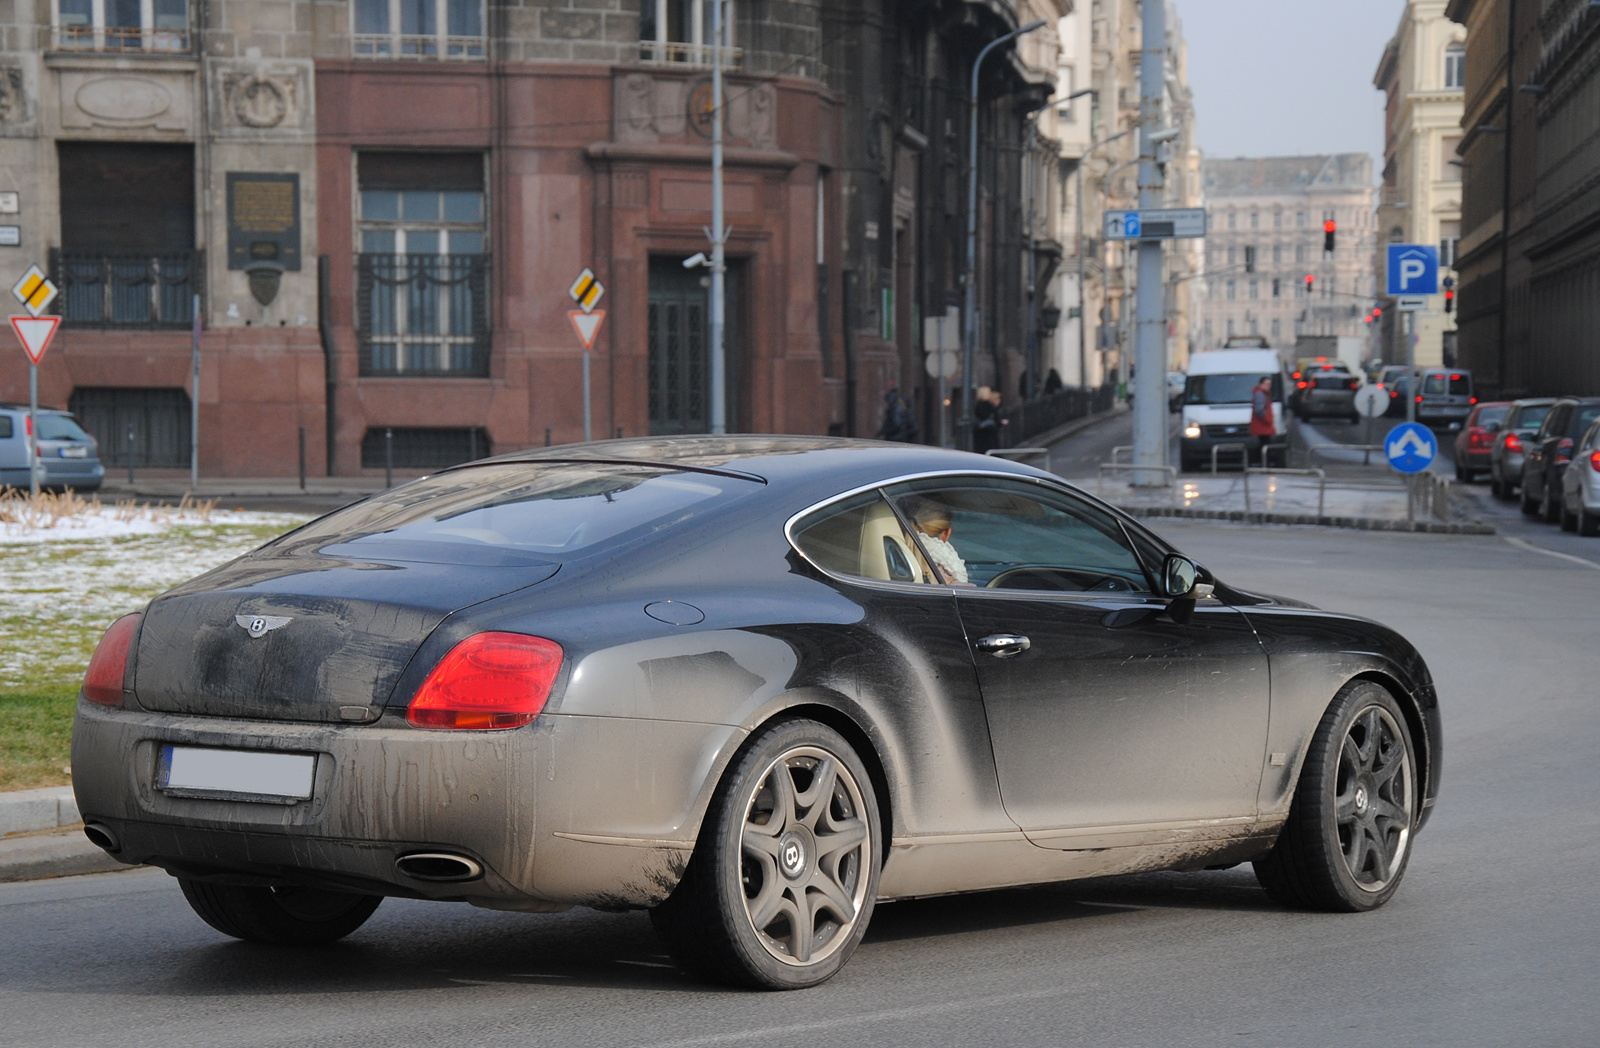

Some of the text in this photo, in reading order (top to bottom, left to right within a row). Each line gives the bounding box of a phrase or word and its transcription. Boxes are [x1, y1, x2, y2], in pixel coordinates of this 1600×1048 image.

[1400, 259, 1426, 290] P
[251, 618, 265, 631] B
[1355, 789, 1364, 808] B
[786, 845, 799, 866] B
